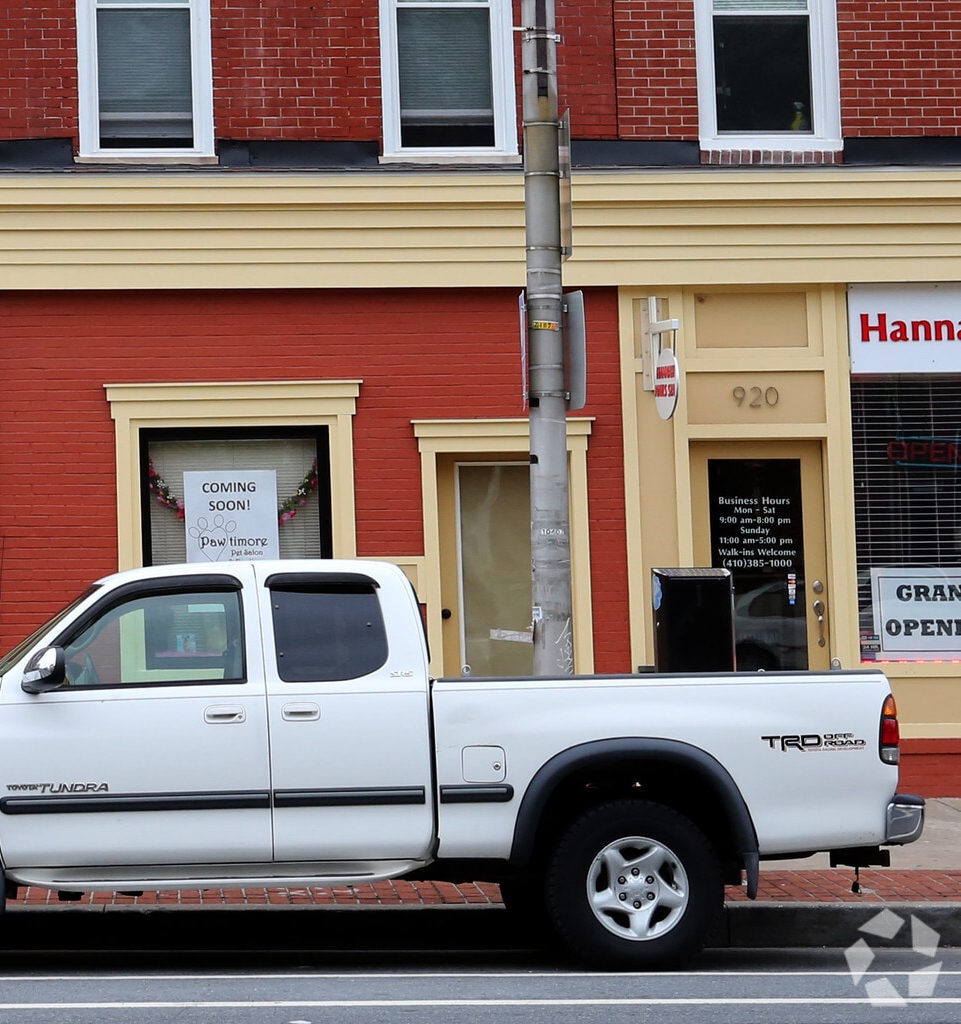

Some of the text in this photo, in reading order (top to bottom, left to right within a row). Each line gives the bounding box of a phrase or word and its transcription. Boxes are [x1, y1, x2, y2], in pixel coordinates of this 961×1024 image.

[860, 313, 961, 342] Hann
[732, 386, 779, 408] 920
[202, 482, 256, 493] COMING
[208, 499, 251, 511] SOON!
[718, 496, 790, 505] Business Hours
[734, 506, 753, 514] Mon
[763, 506, 776, 514] Sat
[719, 516, 791, 525] 9:00 am-8:00 pm
[740, 526, 770, 536] Sunday
[779, 538, 793, 546] pm
[231, 549, 242, 557] Pet
[718, 548, 796, 556] Walk-ins Welcome
[722, 558, 792, 568] (410)385-1000
[896, 584, 961, 602] GRAN
[761, 734, 823, 752] TRD
[823, 739, 867, 747] ROAD
[39, 783, 109, 793] TUNDRA
